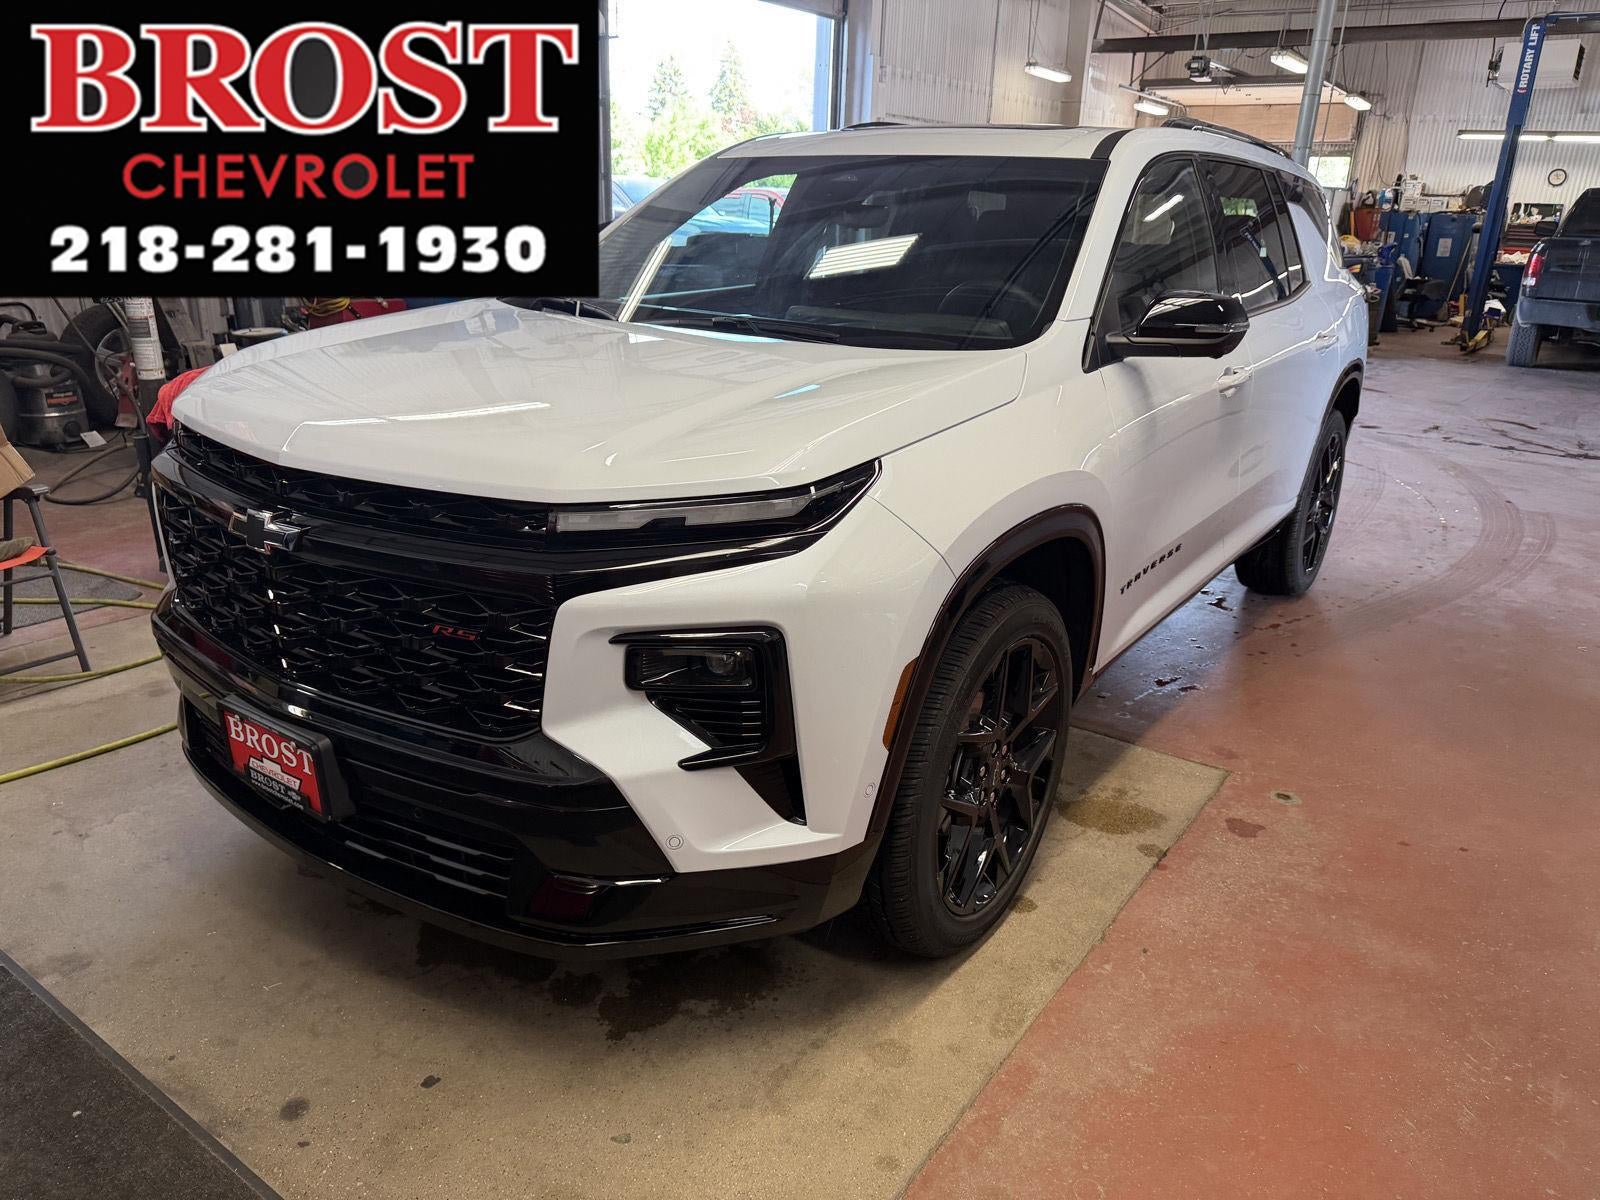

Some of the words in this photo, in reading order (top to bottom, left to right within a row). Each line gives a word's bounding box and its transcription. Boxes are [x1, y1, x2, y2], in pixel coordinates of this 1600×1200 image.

[1519, 48, 1536, 88] ROTARY
[1528, 23, 1541, 46] LIFT
[1120, 543, 1182, 595] TRAVERSE
[432, 624, 477, 641] RS
[227, 715, 314, 775] BROST
[250, 769, 286, 795] BROST
